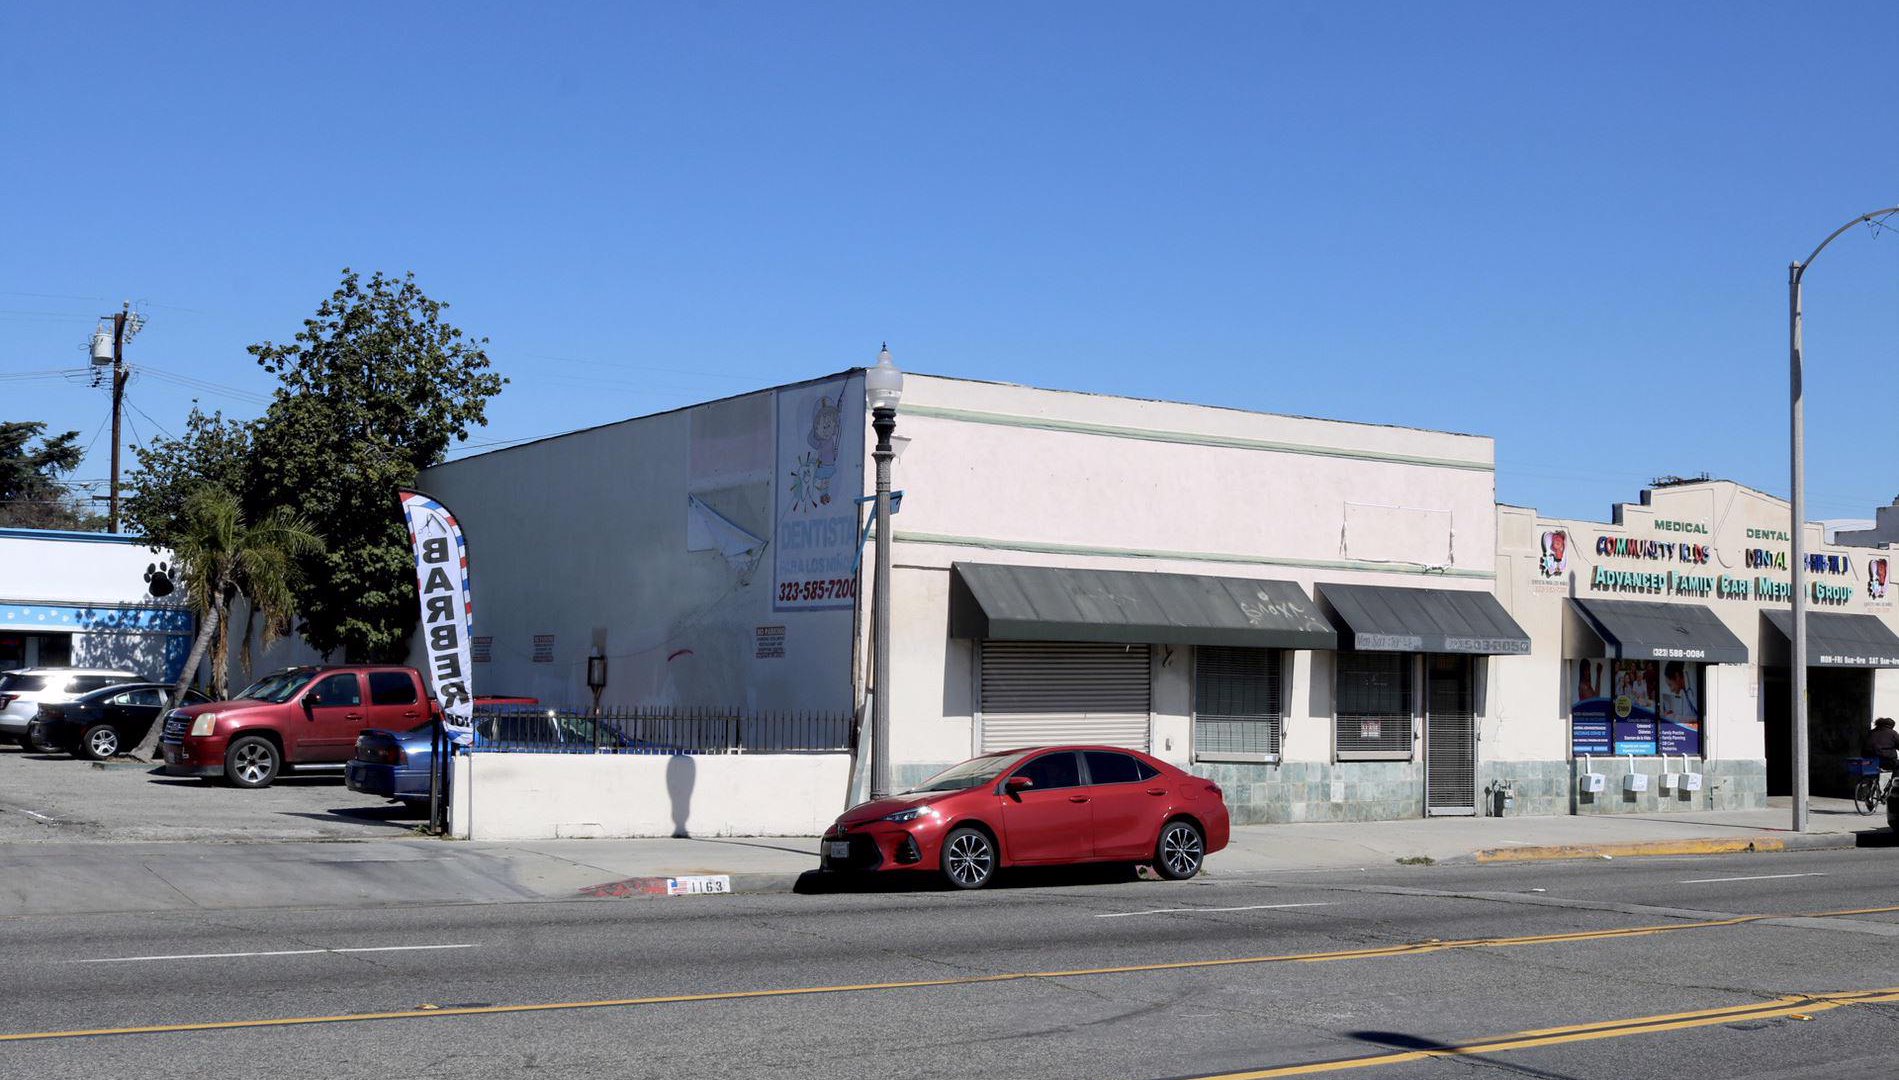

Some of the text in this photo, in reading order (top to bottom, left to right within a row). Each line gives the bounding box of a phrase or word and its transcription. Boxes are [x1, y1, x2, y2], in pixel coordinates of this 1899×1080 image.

[782, 516, 856, 549] DENTISTA
[1654, 519, 1708, 534] MEDICAL
[1746, 528, 1790, 541] DENTAL
[778, 578, 856, 602] 323-585-7200
[1592, 565, 1667, 595] ADVANCED
[1669, 570, 1716, 597] FAMILY
[1813, 581, 1855, 605] GROUP
[692, 881, 724, 893] 1163
